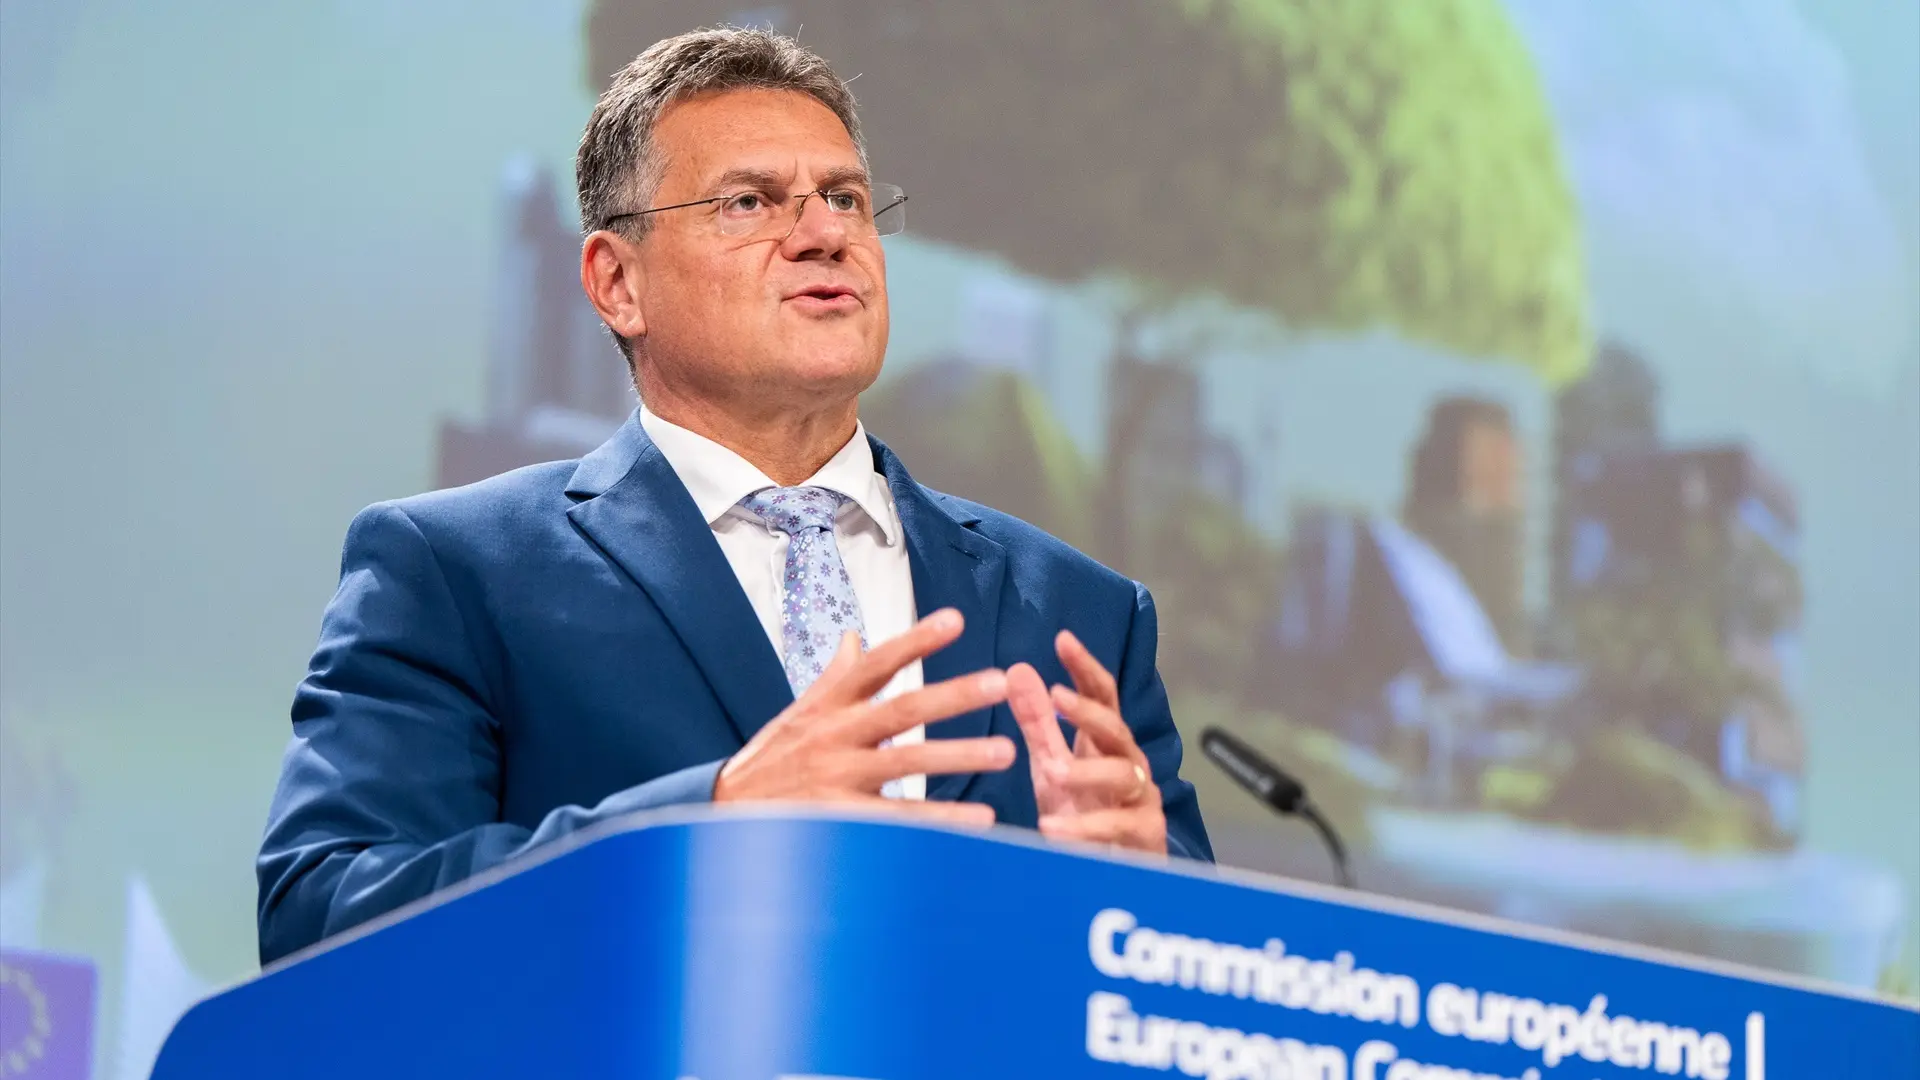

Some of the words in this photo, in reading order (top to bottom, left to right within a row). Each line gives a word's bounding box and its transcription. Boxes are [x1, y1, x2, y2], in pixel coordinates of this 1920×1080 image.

[1086, 990, 1348, 1080] European
[1088, 907, 1420, 1028] Commission
[1426, 982, 1732, 1080] européenne
